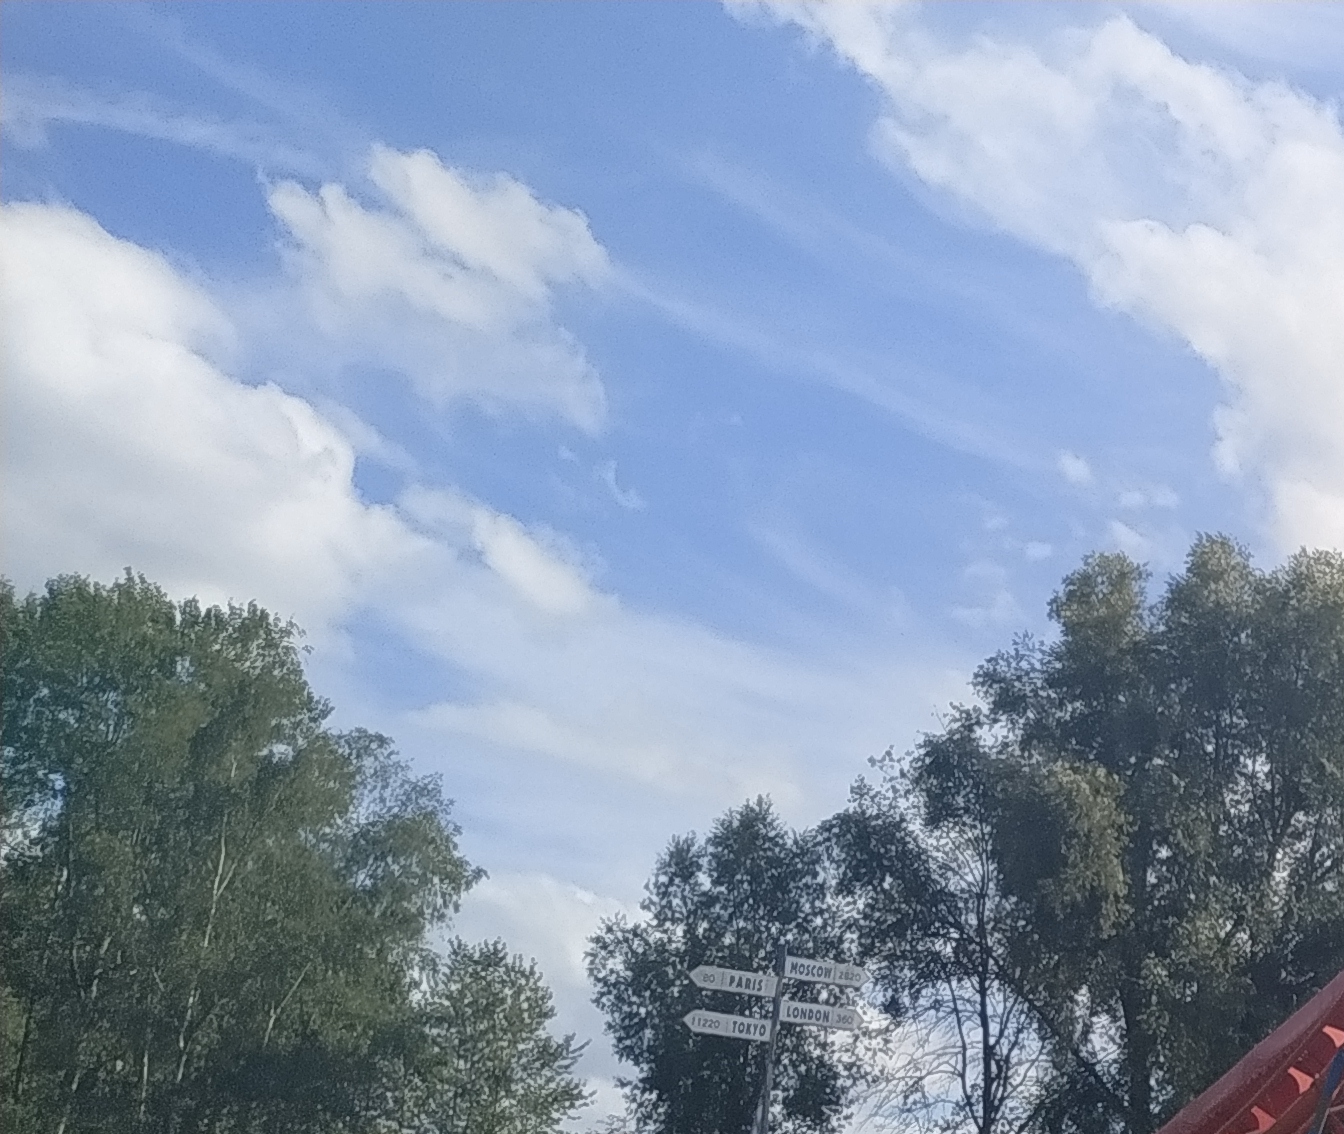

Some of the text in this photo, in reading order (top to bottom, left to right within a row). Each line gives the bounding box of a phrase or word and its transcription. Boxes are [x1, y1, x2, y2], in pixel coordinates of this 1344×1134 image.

[789, 961, 833, 979] MOSCOW
[728, 974, 764, 993] PARIS
[786, 1005, 830, 1024] LONDON
[731, 1020, 767, 1037] TOKYO
